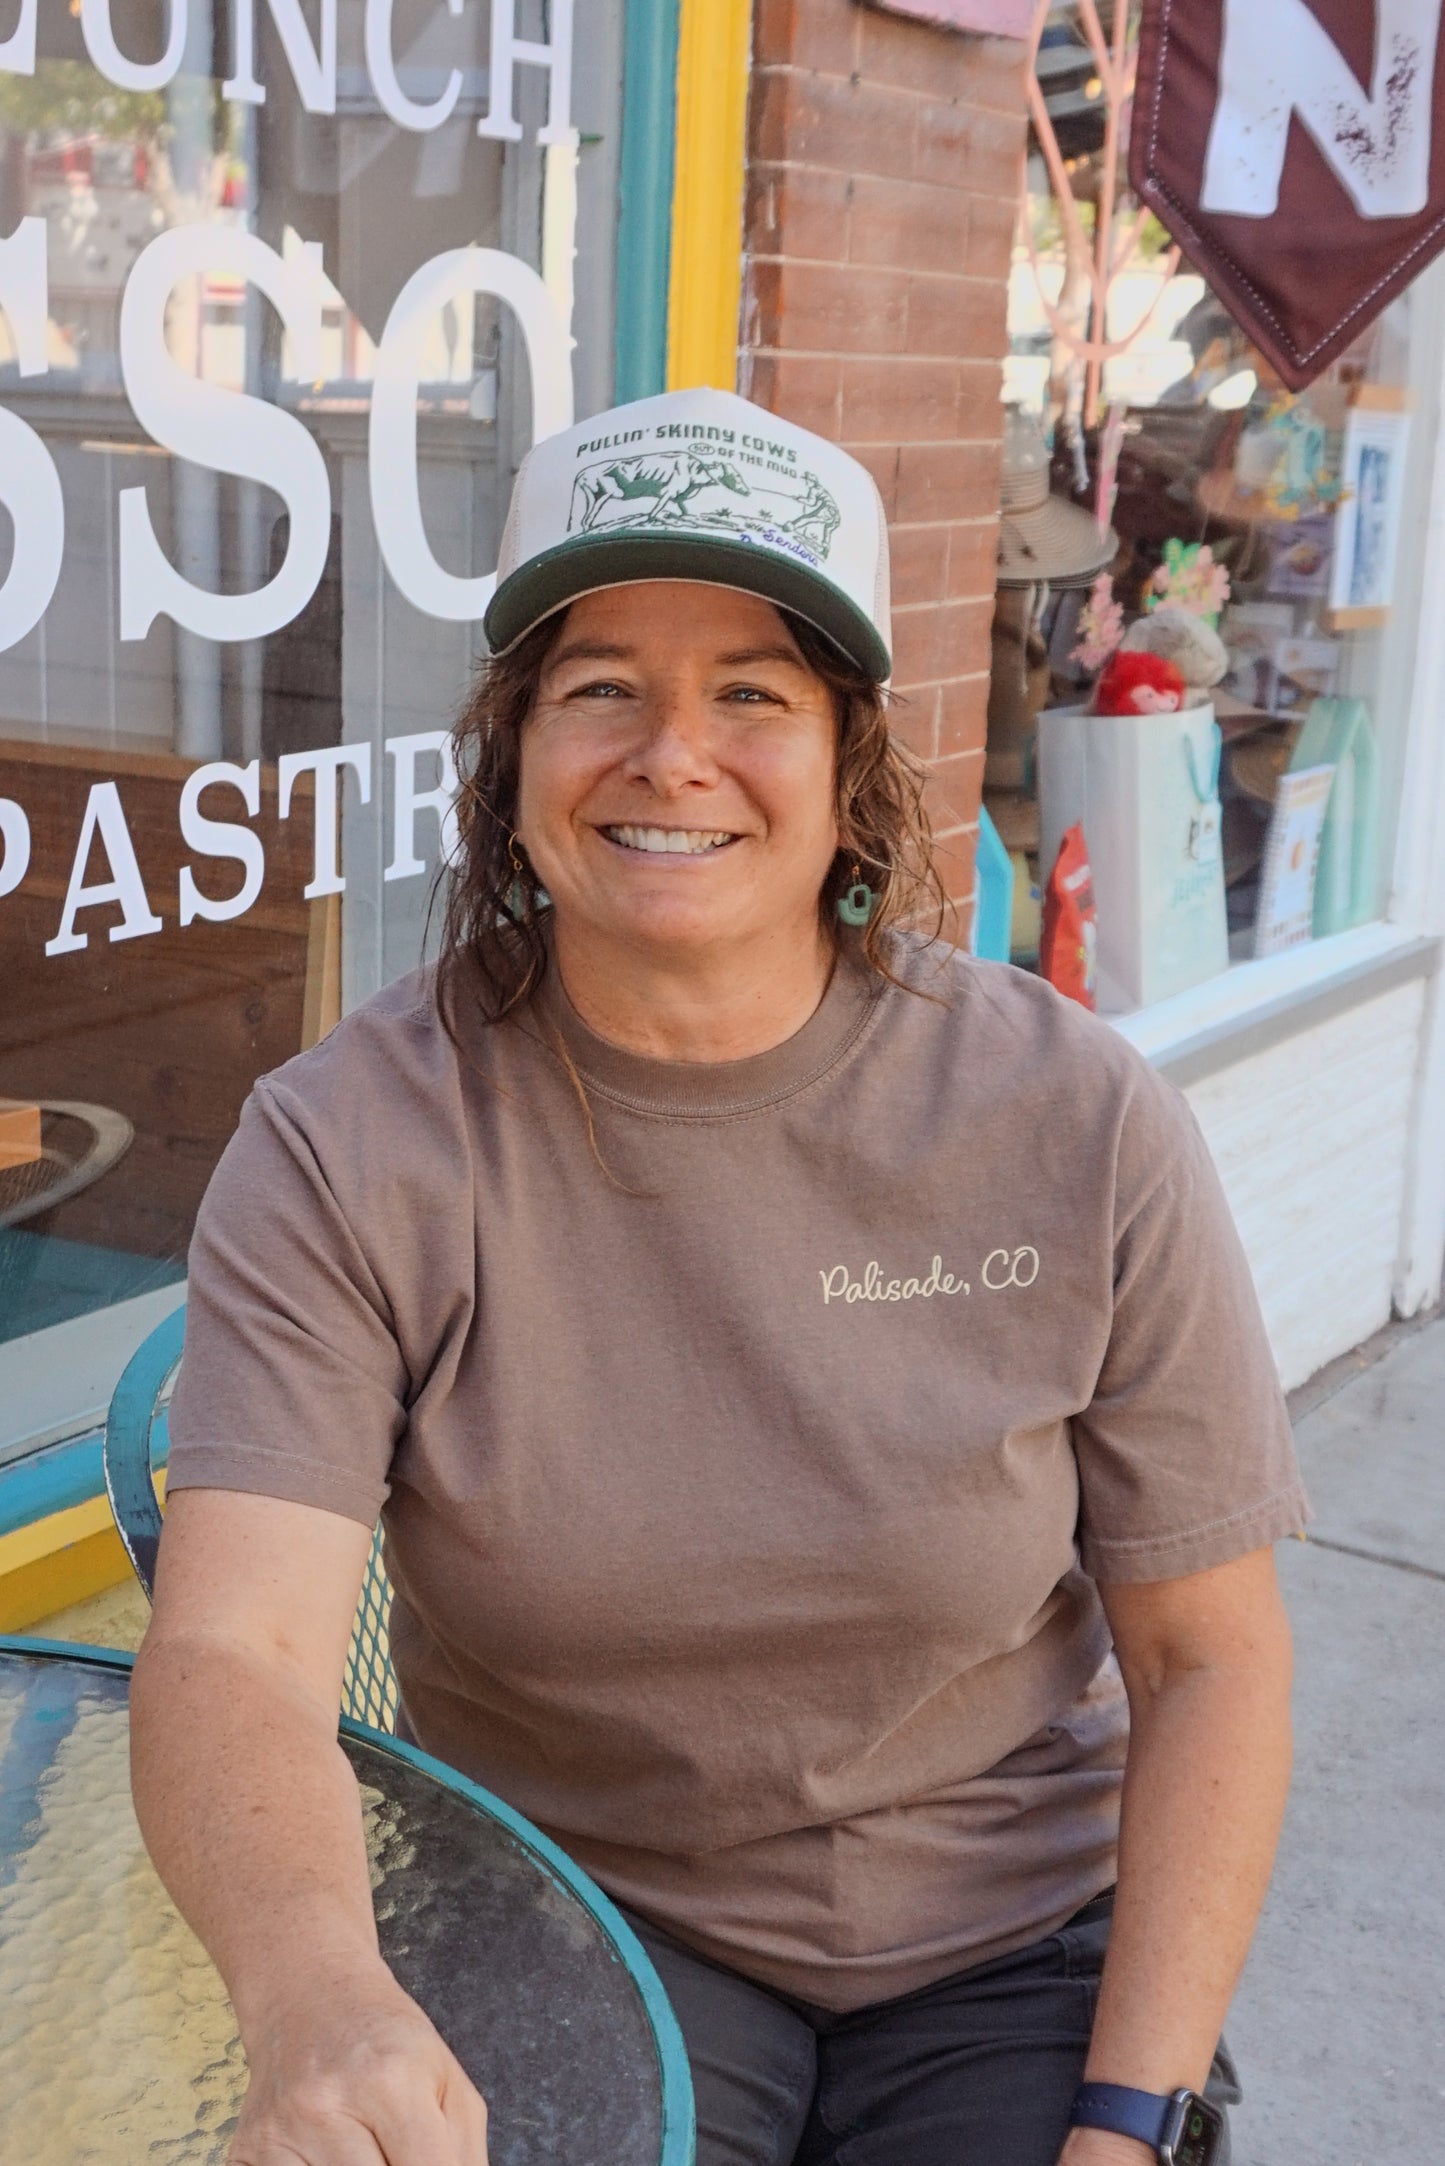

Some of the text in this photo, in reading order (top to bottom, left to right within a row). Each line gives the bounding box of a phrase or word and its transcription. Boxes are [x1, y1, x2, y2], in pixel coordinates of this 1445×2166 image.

[0, 0, 574, 145] UNCH
[717, 446, 736, 459] OF
[738, 451, 765, 467] THE
[765, 459, 799, 479] MUD
[741, 434, 798, 463] COWS
[0, 730, 474, 957] ASTR
[819, 1245, 1040, 1304] Palisade, CO
